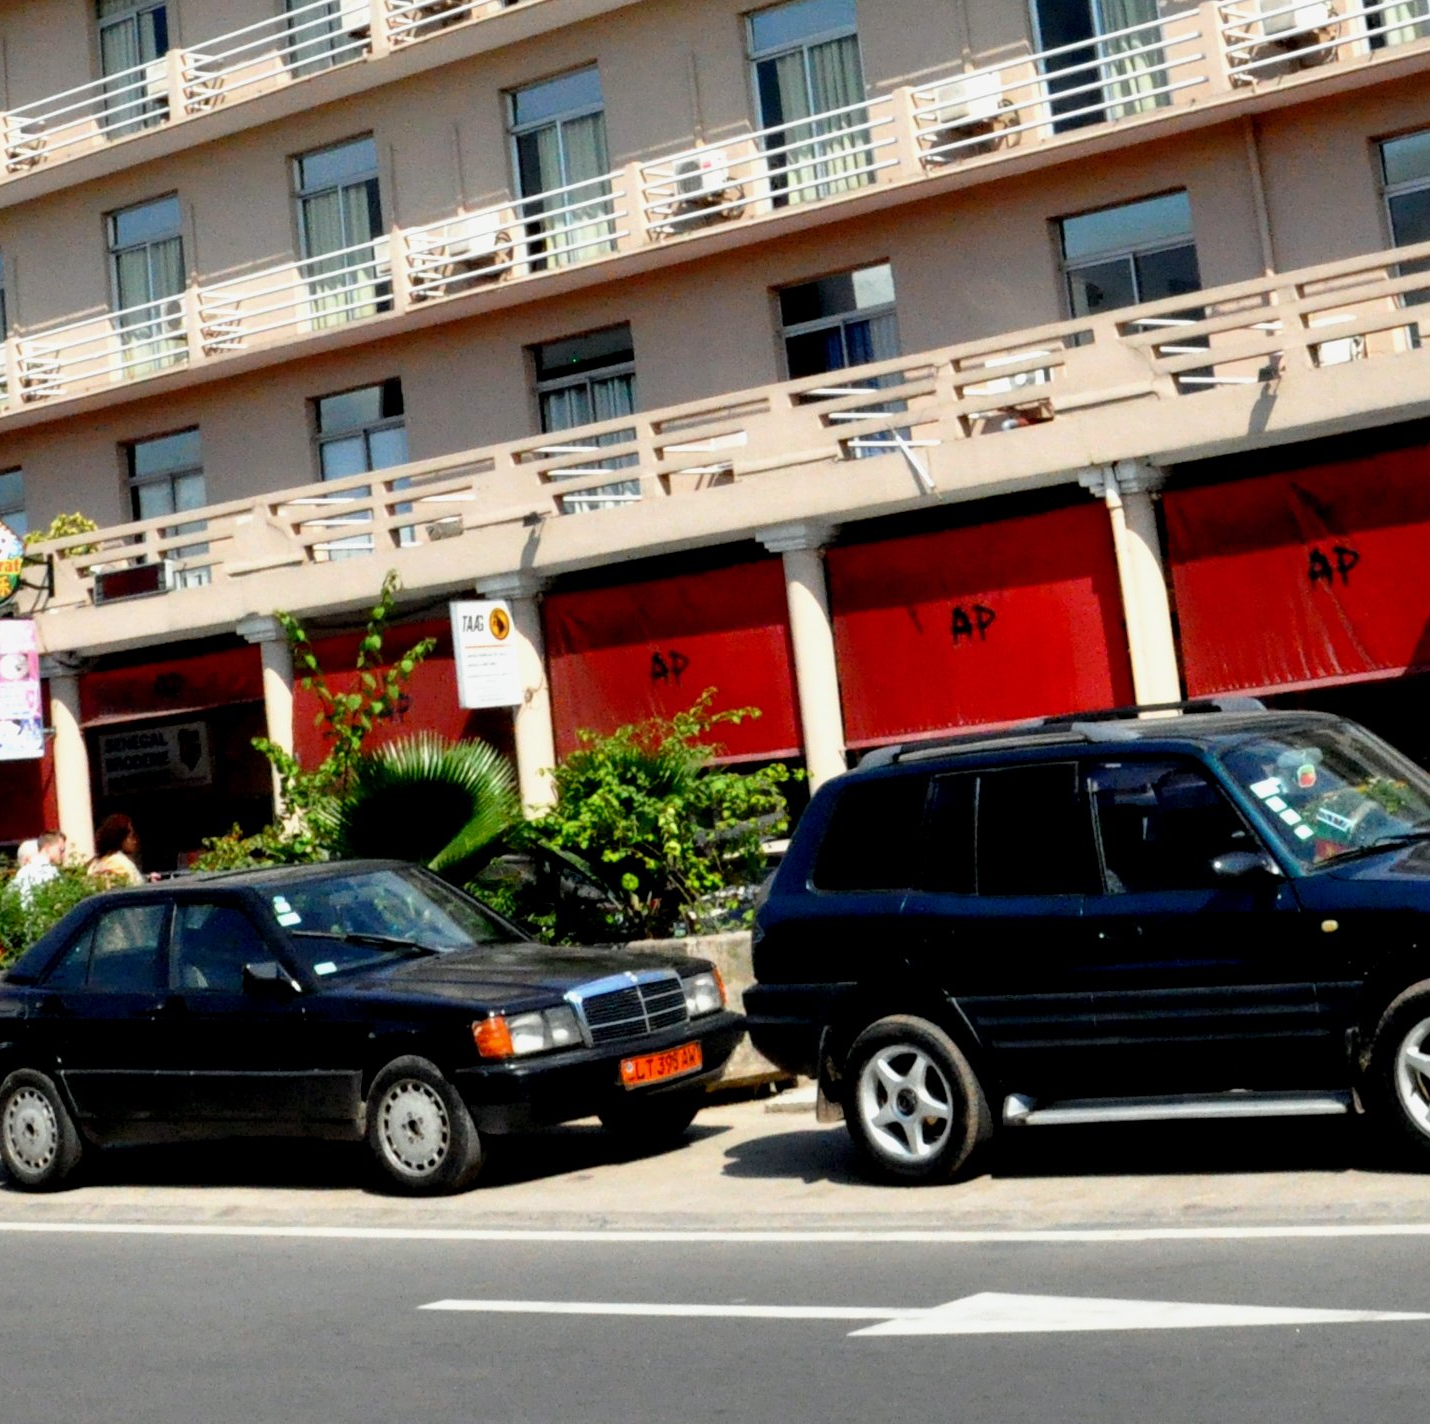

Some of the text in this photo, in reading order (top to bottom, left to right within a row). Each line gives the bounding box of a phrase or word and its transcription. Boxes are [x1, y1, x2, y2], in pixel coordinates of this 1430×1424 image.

[1309, 546, 1361, 589] AP
[462, 615, 484, 633] TAAG
[952, 605, 995, 643] AP
[652, 650, 689, 684] AP
